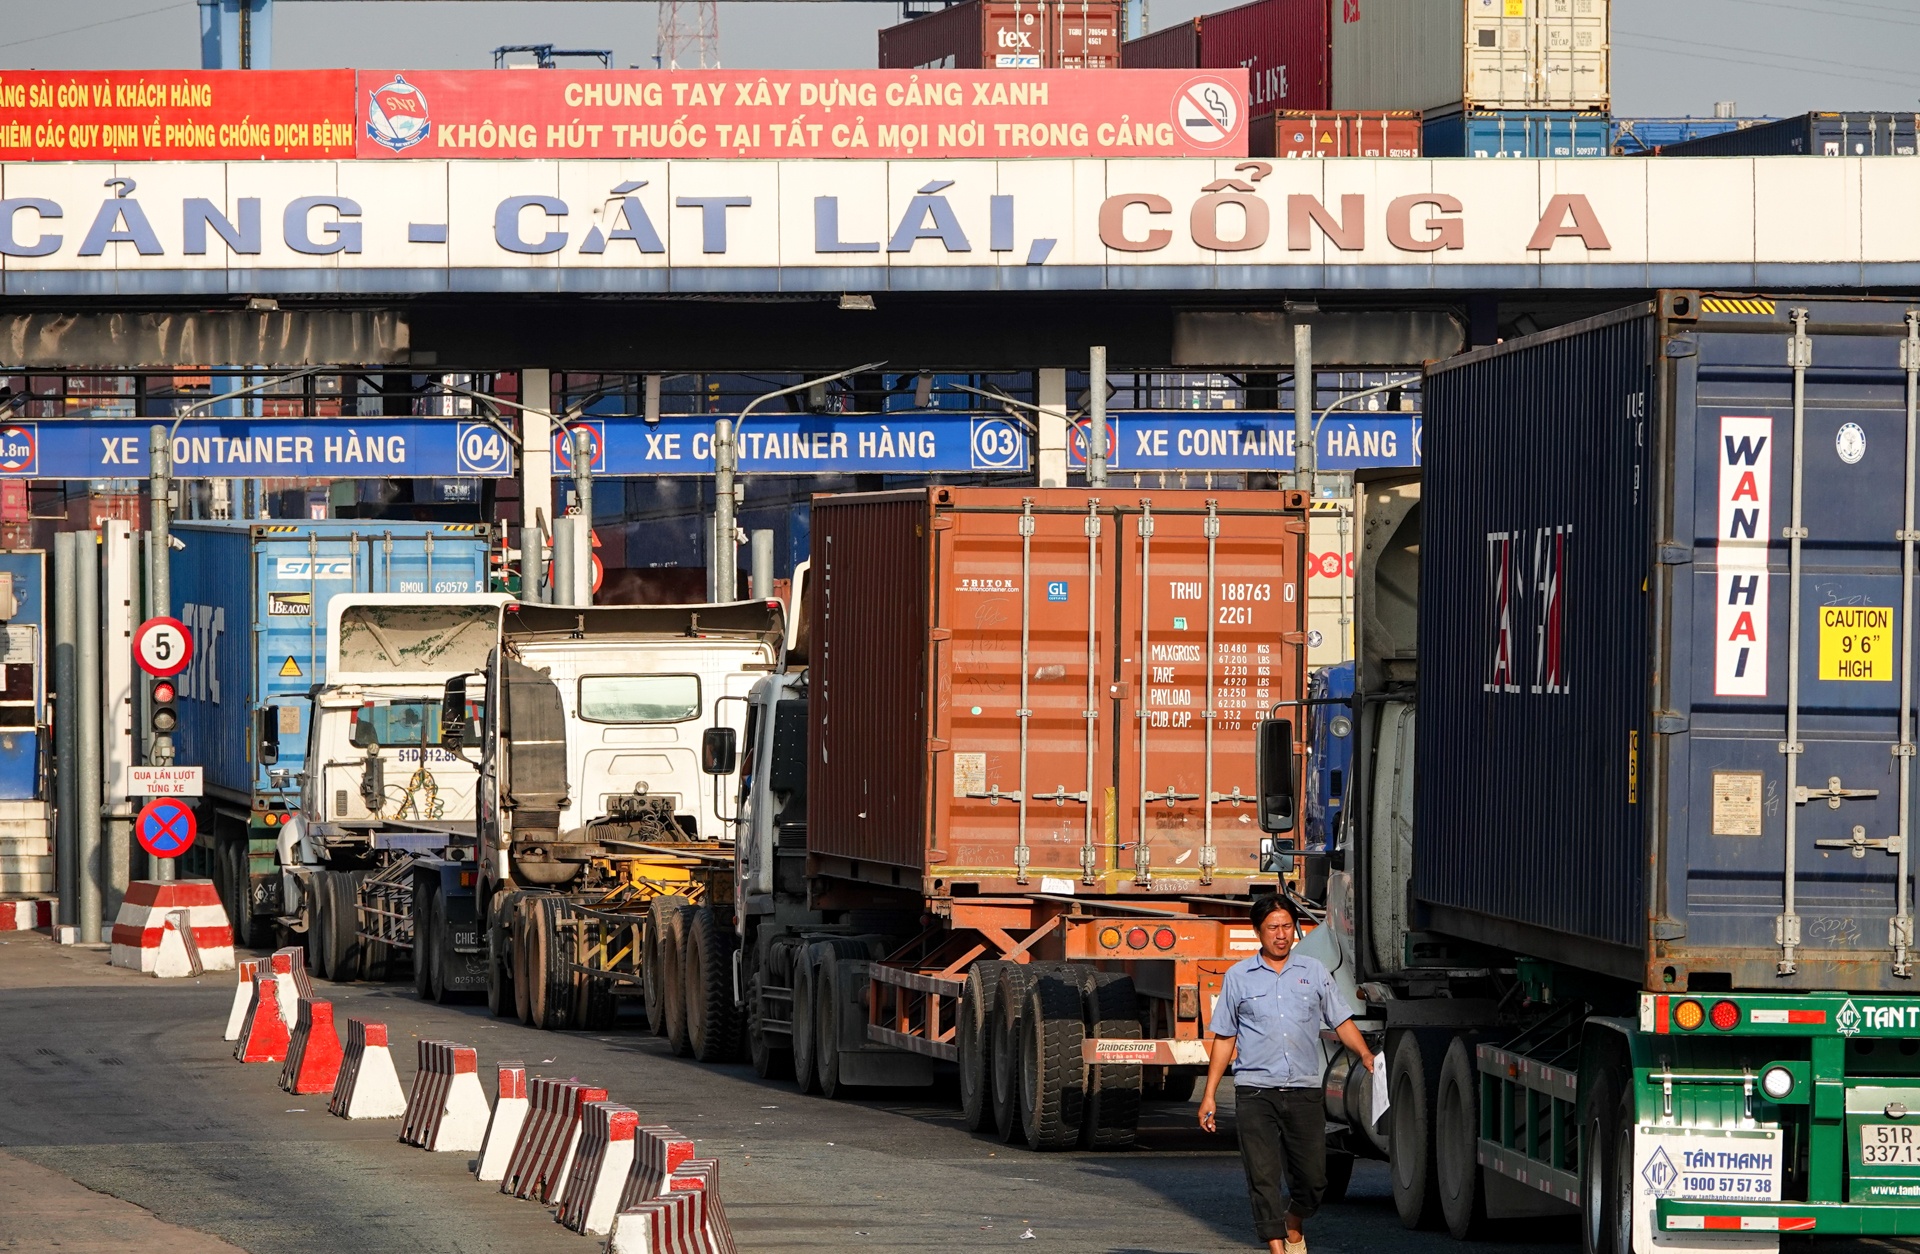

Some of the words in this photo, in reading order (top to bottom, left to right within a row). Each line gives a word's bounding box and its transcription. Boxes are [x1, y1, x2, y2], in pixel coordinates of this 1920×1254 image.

[997, 26, 1032, 48] tex
[997, 57, 1039, 65] SITC
[30, 79, 54, 107] SÀI
[57, 79, 90, 107] GÒN
[93, 79, 113, 107] VÀ
[116, 78, 167, 107] KHÁCH
[171, 78, 212, 107] HÀNG
[564, 83, 662, 107] CHUNG
[672, 83, 726, 106] TAY
[735, 78, 793, 106] XÂY
[800, 79, 877, 113] DỰNG
[885, 75, 963, 107] CẢNG
[972, 82, 1049, 106] XANH
[35, 119, 65, 148] CÁC
[69, 124, 99, 149] QUY
[102, 124, 138, 153] ĐỊNH
[142, 115, 162, 147] VỀ
[165, 119, 215, 147] PHÒNG
[219, 115, 270, 147] CHỐNG
[274, 124, 309, 153] DỊCH
[313, 118, 352, 153] BỆNH
[437, 120, 538, 148] KHÔNG
[547, 118, 604, 148] HÚT
[612, 115, 707, 148] THUỐC
[715, 124, 760, 154] TẠI
[770, 114, 823, 147] TẤT
[831, 116, 869, 147] CẢ
[878, 123, 928, 154] MỌI
[938, 120, 985, 147] NƠI
[996, 123, 1088, 147] TRONG
[1097, 115, 1174, 147] CẢNG
[0, 177, 362, 256] CẢNG
[493, 180, 752, 254] CÁT
[813, 179, 1057, 266] LÁI,
[1098, 161, 1466, 252] CỔNG
[1526, 193, 1612, 252] A
[101, 435, 139, 464] XE
[164, 435, 314, 464] ONTAINER
[324, 428, 406, 464] HÀNG
[466, 434, 501, 462] 04
[645, 433, 681, 461] XE
[859, 425, 936, 458] HÀNG
[980, 429, 1013, 457] 03
[1136, 429, 1168, 457] XE
[1177, 428, 1312, 457] CONTAINE
[1328, 423, 1397, 458] HÀNG
[1725, 435, 1767, 539] WAN
[279, 562, 350, 574] SITC
[400, 582, 423, 593] BMOU
[435, 582, 468, 593] 650579
[962, 579, 1012, 588] TRITON
[1048, 583, 1067, 595] GL
[1169, 582, 1202, 600] TRHU
[1221, 583, 1271, 601] 188763
[1285, 583, 1295, 602] 0
[275, 602, 309, 614] BEACON
[1219, 606, 1252, 624] 22G1
[1728, 575, 1759, 677] HAI
[1825, 610, 1887, 627] CAUTION
[156, 633, 171, 660] 5
[1151, 644, 1200, 661] MAXGROSS
[1218, 644, 1247, 653] 30.480
[1257, 644, 1270, 653] KGS
[1218, 655, 1247, 664] 67.200
[1258, 656, 1270, 664] LBS
[1152, 666, 1175, 683] TARE
[1224, 666, 1247, 675] 2.230
[1258, 667, 1270, 675] KGS
[1839, 660, 1873, 678] HIGH
[1223, 678, 1247, 686] 4.920
[1257, 678, 1269, 686] LBS
[1151, 688, 1191, 705] PAYLOAD
[1218, 688, 1246, 697] 28.250
[1257, 688, 1269, 697] KGS
[1218, 700, 1246, 708] 62.280
[1257, 700, 1269, 708] LBS
[1151, 711, 1170, 727] CUB.
[1172, 711, 1192, 727] CAP.
[1223, 711, 1241, 719] 33.2
[1218, 722, 1241, 730] 1.170
[134, 771, 151, 780] QUA
[173, 784, 184, 793] XE
[1098, 1043, 1154, 1053] BRIDGESTONE
[1877, 1127, 1912, 1143] 51R
[1683, 1149, 1715, 1169] TÂN
[1717, 1152, 1773, 1170] THANH
[1652, 1162, 1667, 1185] KCT
[1683, 1177, 1715, 1191] 1900
[1719, 1178, 1734, 1191] 57
[1737, 1178, 1752, 1192] 57
[1755, 1179, 1772, 1193] 38
[1682, 1193, 1772, 1201] wwwtanthanhcontainer.com
